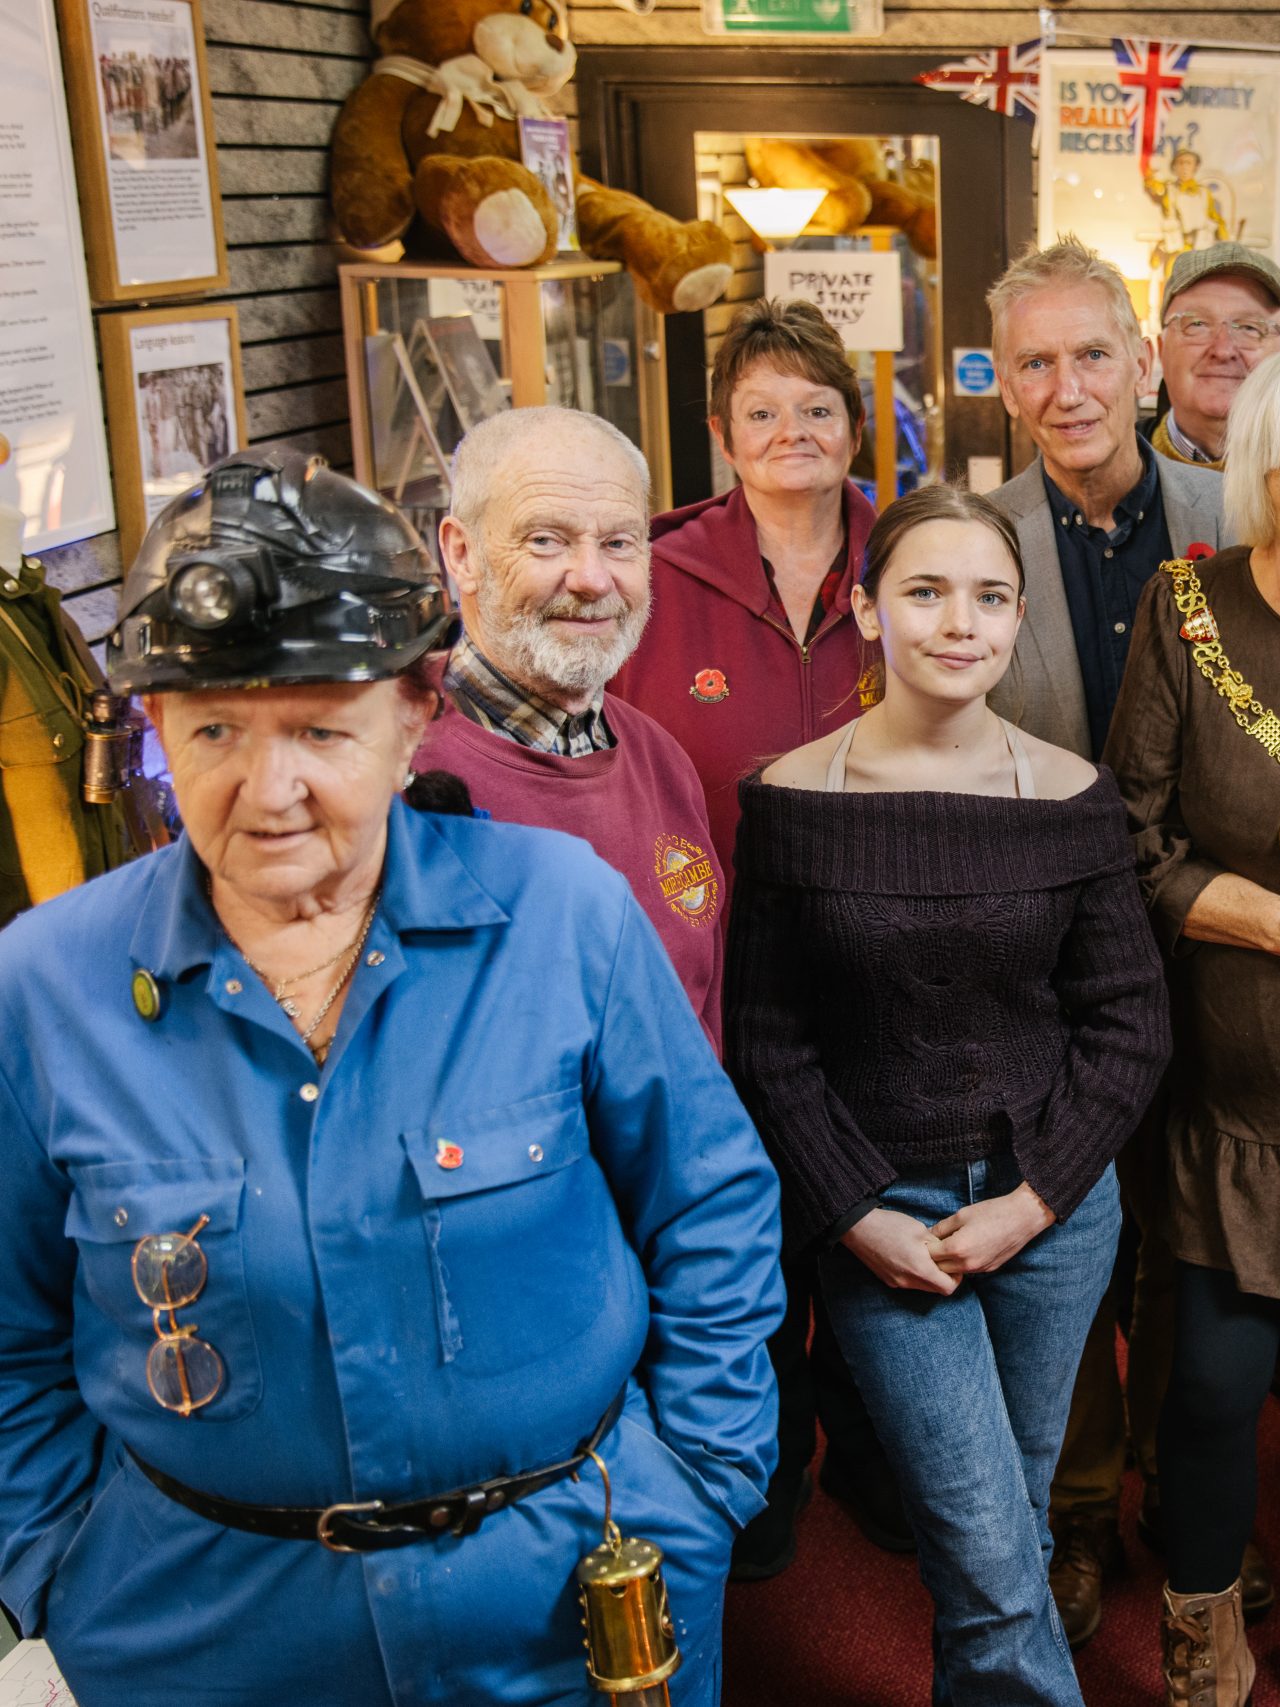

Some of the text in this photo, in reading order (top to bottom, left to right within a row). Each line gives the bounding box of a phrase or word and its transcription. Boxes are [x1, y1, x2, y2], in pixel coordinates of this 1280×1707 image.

[1060, 81, 1077, 101] IS
[788, 271, 873, 291] PRIVATE
[815, 290, 871, 305] STAFF
[826, 308, 865, 324] NLY
